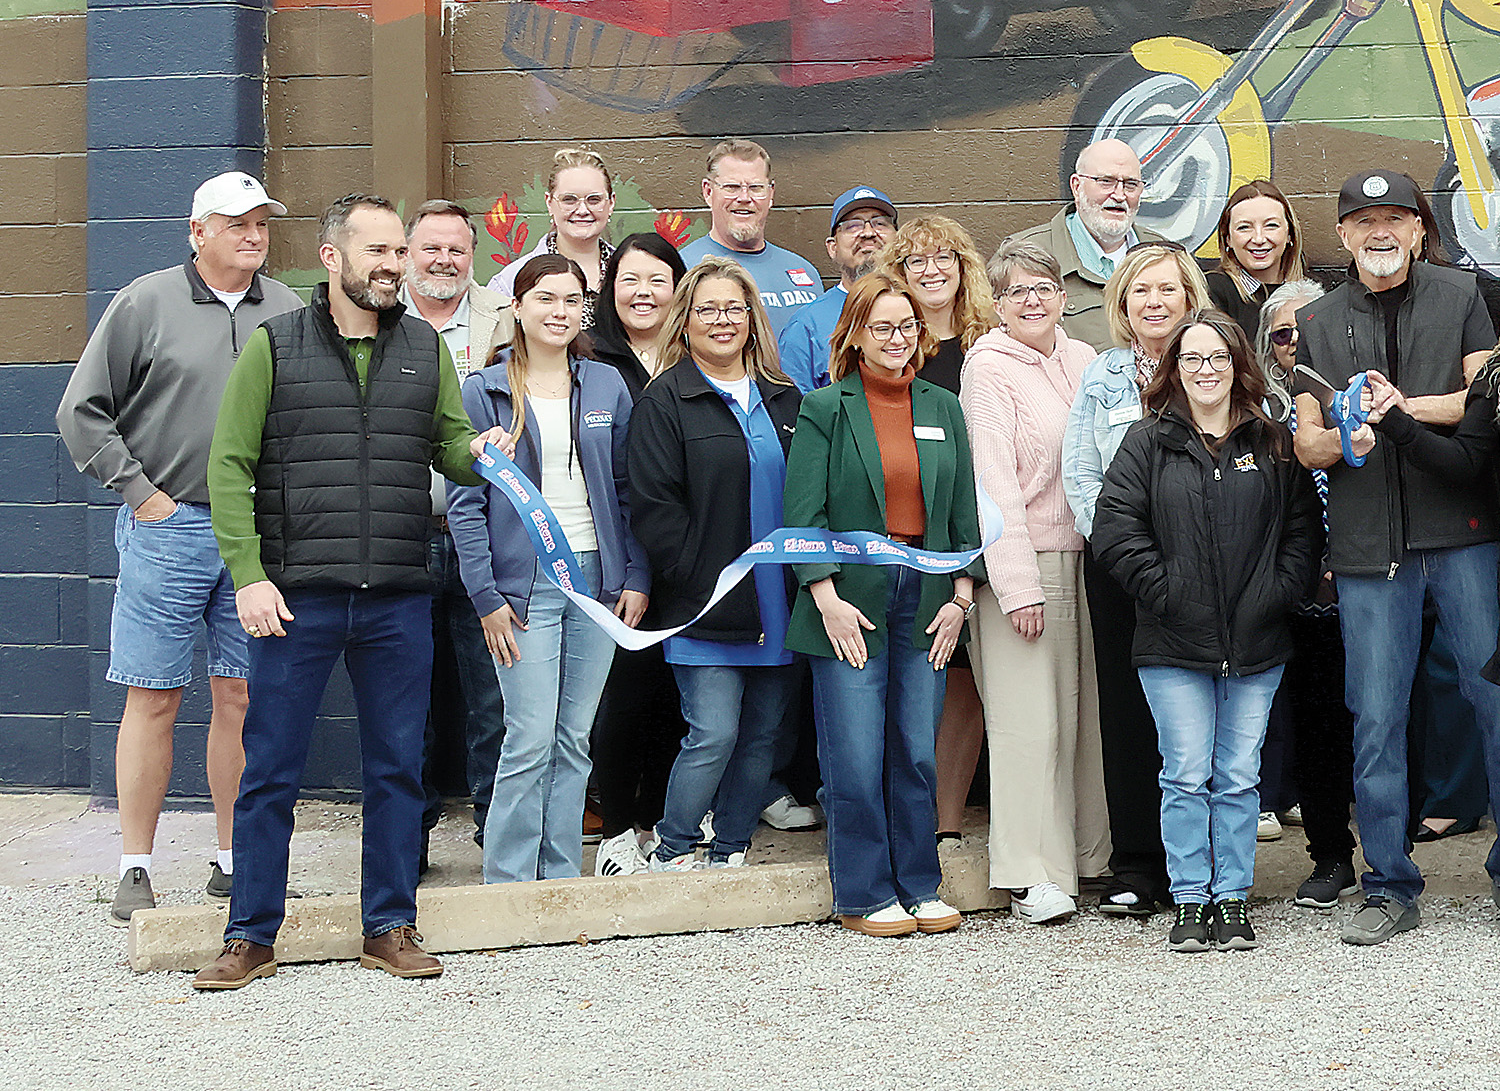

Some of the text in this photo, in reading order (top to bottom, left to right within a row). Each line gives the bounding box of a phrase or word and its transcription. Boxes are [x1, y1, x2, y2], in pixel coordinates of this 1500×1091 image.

[507, 476, 532, 505] Reno
[538, 520, 557, 554] Reno
[797, 538, 827, 553] Reno
[558, 570, 575, 592] Ren
